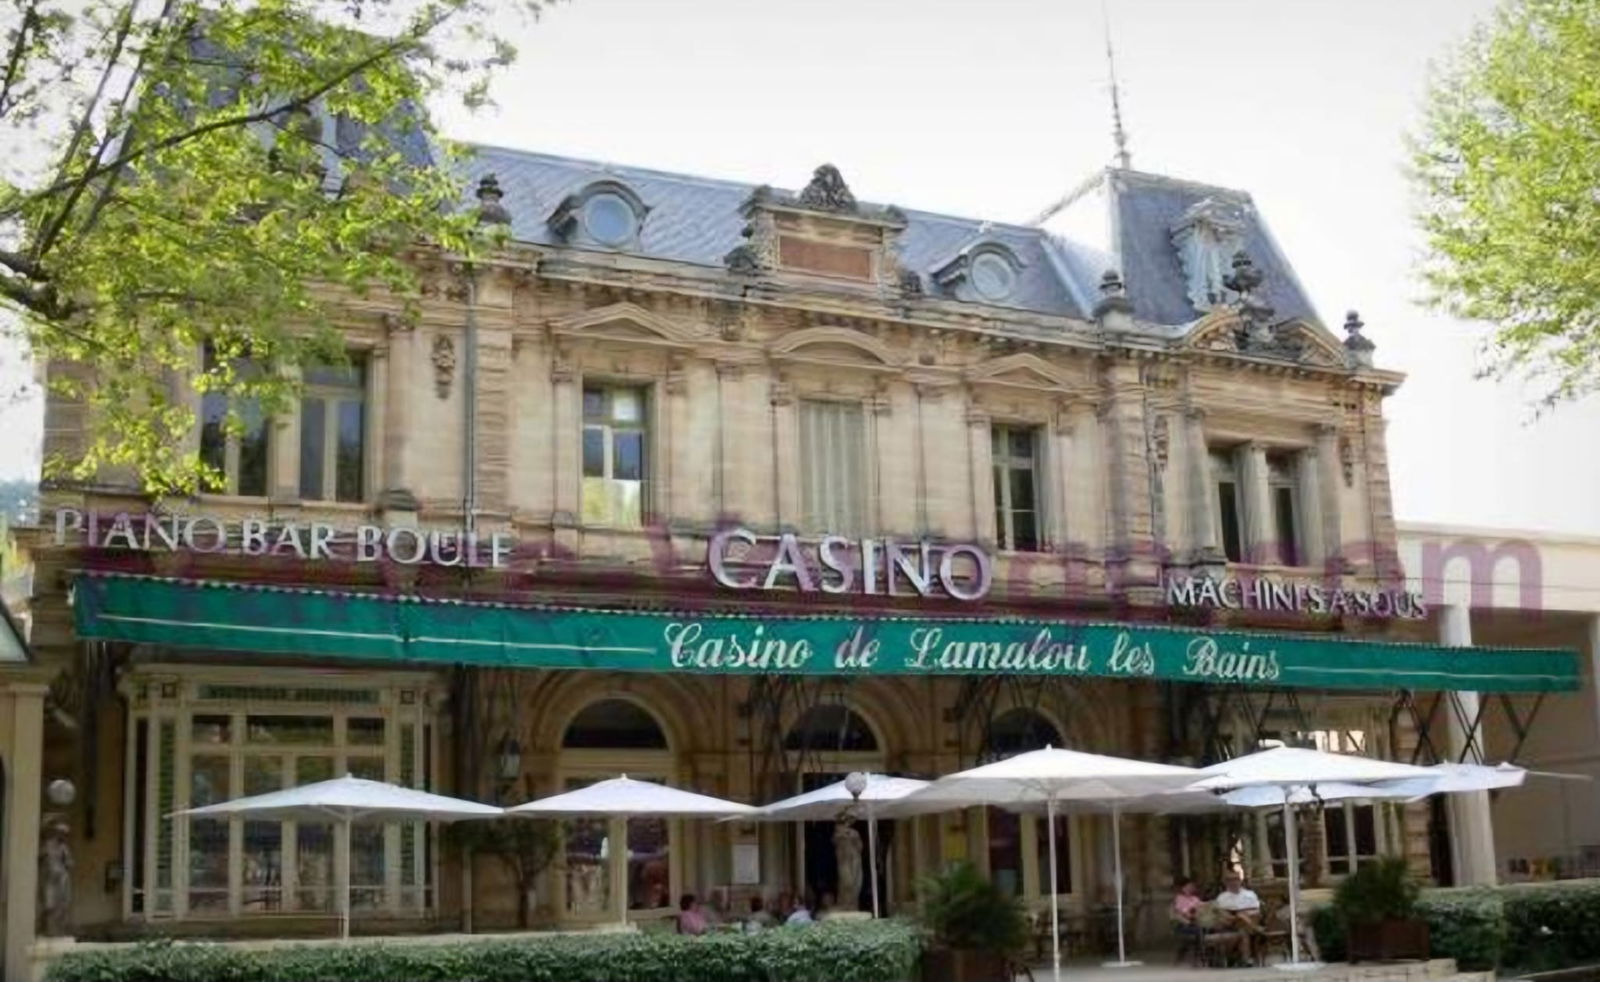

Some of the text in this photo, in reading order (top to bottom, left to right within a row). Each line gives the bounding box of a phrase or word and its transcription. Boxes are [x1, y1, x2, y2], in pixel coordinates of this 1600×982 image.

[55, 508, 513, 567] PIANO BAR BOULE
[708, 528, 993, 601] CASINO
[1167, 576, 1326, 613] MACHINES
[1354, 589, 1428, 620] SOUS
[664, 622, 1281, 681] Casino de Lamalou les Bains
